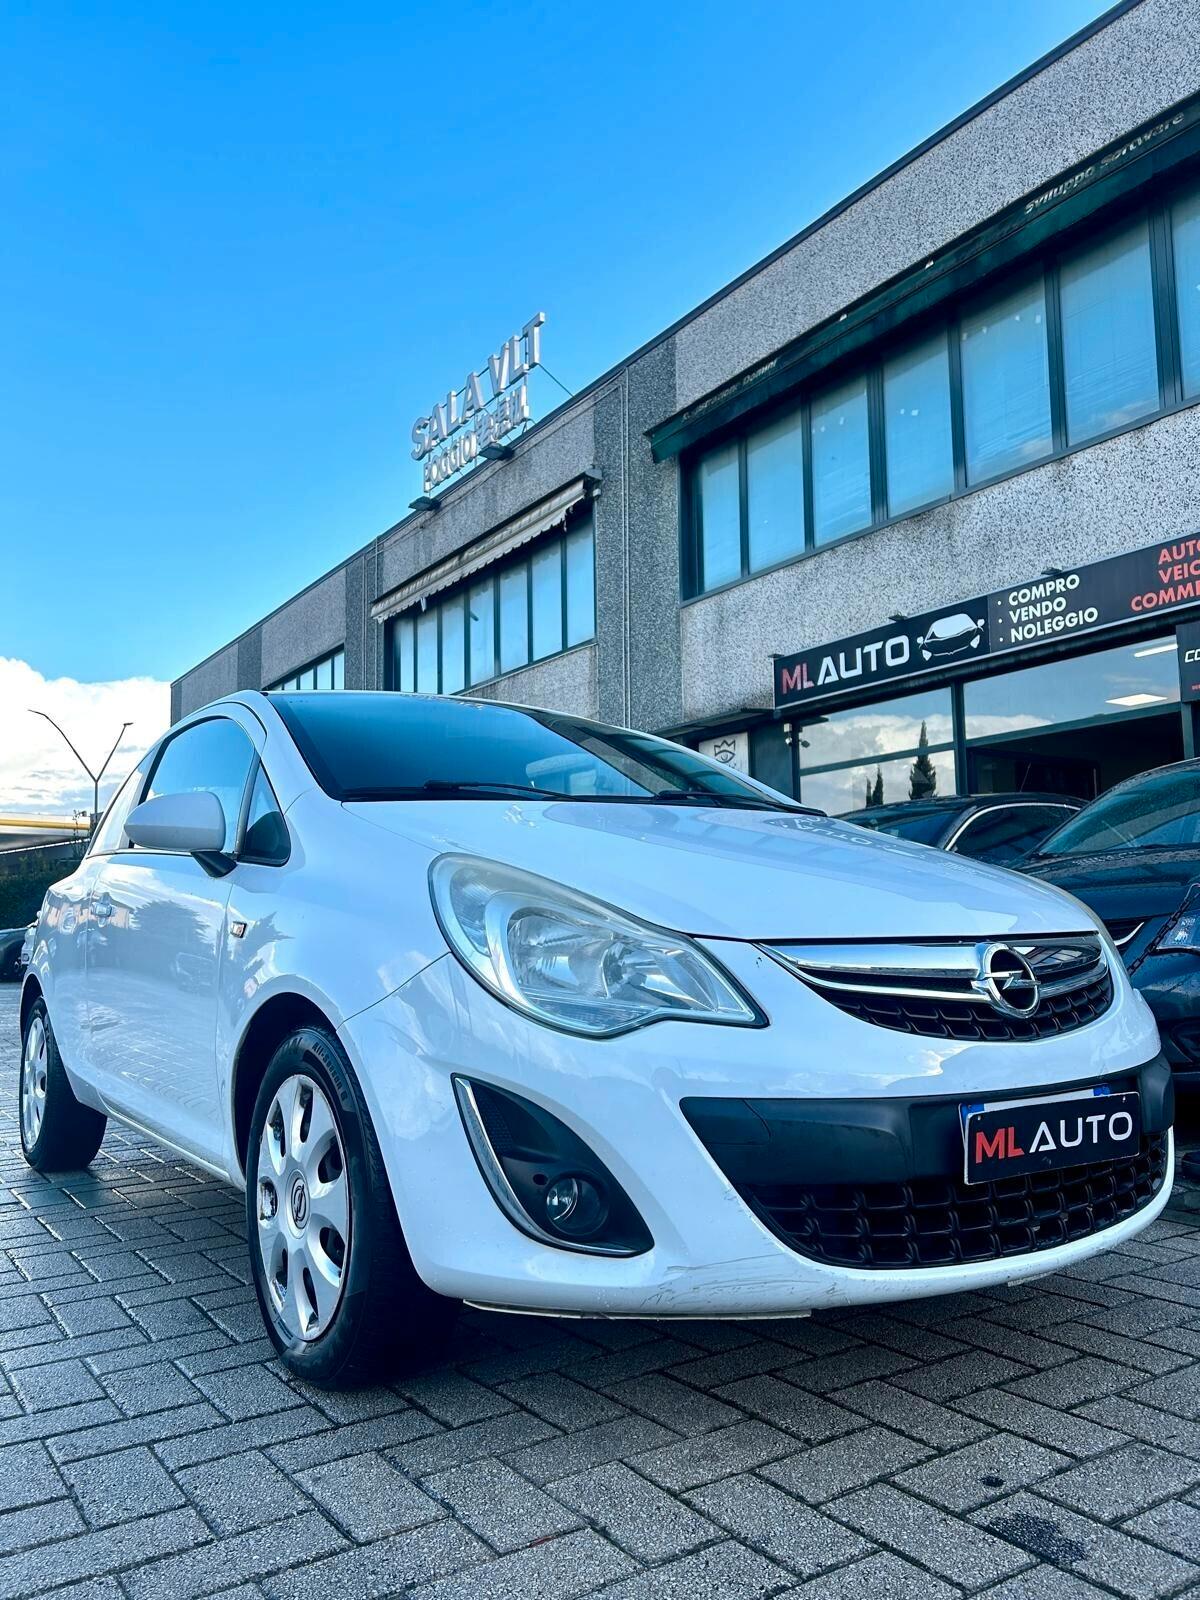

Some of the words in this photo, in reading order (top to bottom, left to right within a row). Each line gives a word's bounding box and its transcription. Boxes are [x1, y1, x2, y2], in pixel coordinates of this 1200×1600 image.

[411, 372, 484, 461] SALA
[487, 312, 546, 397] VLT
[1008, 574, 1080, 606] COMPRO
[1009, 597, 1066, 624] VENDO
[1011, 607, 1098, 643] NOLEGGIO
[817, 635, 910, 686] AUTO
[975, 1127, 1025, 1164] ML
[1029, 1111, 1133, 1153] AUTO
